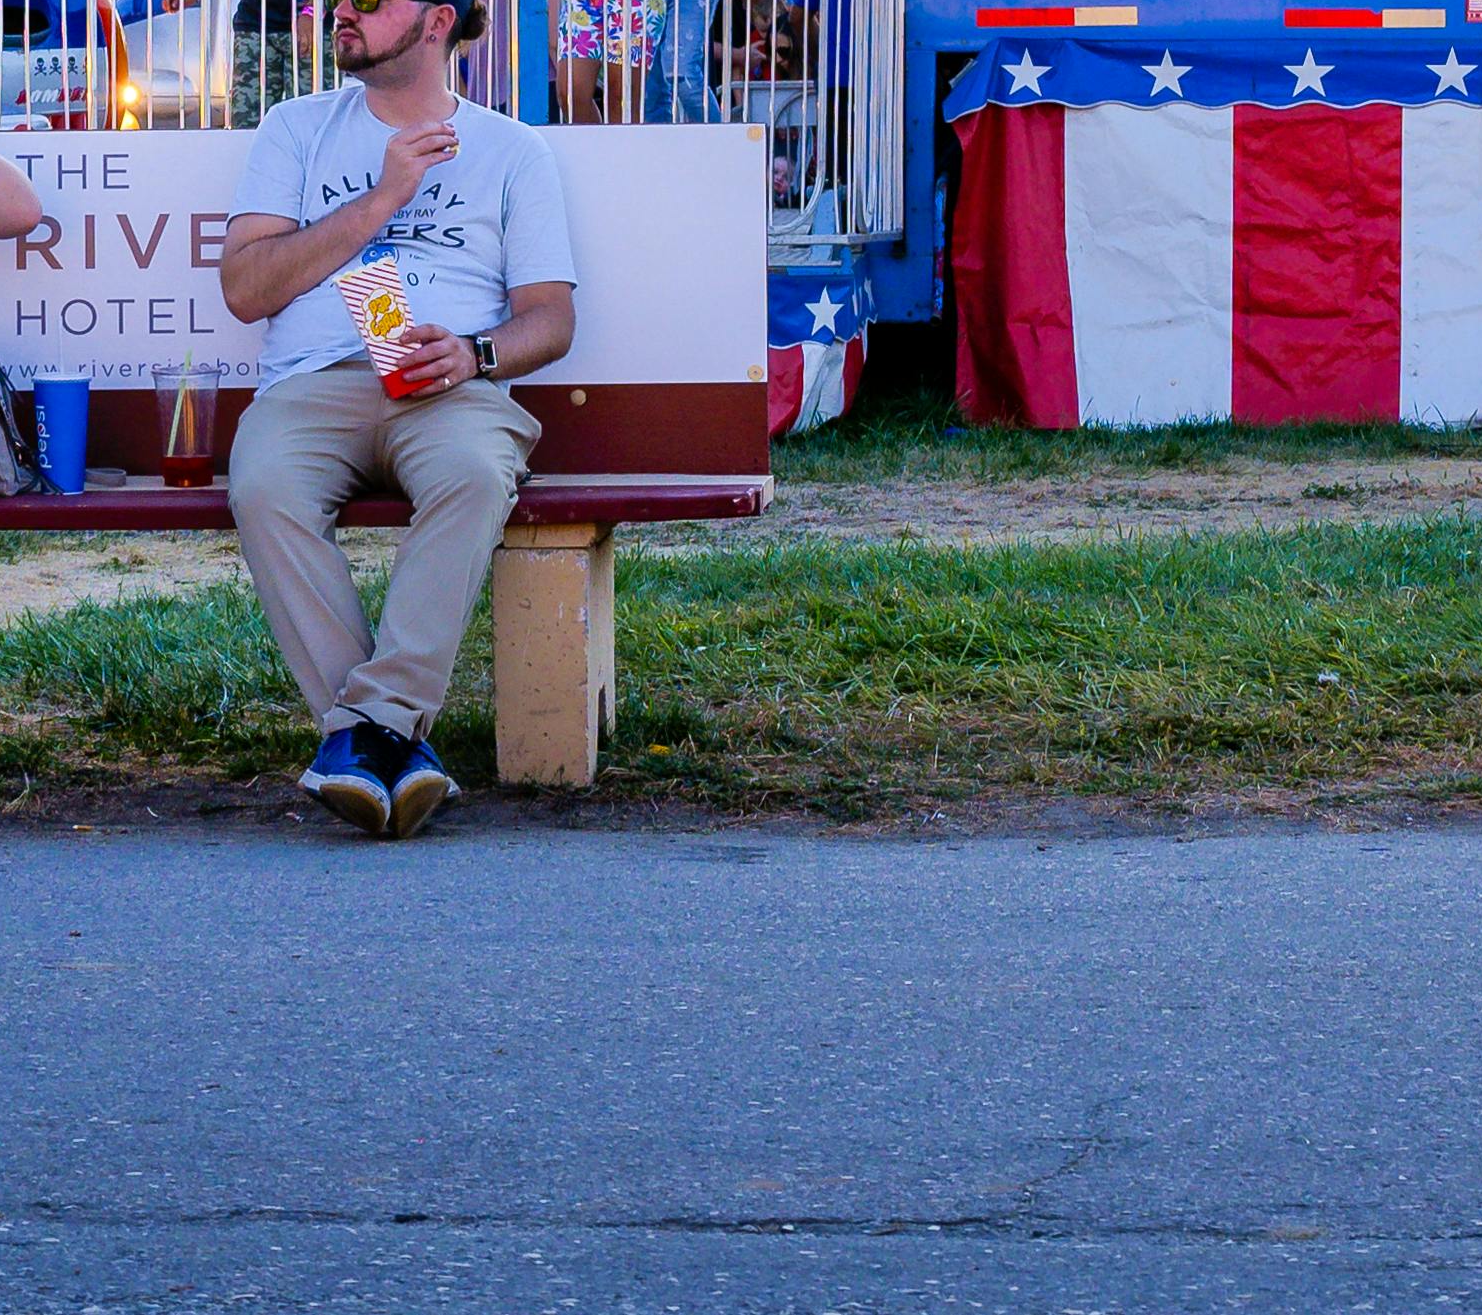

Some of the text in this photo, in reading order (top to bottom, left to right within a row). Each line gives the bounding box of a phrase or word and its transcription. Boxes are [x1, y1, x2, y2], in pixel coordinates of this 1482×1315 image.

[16, 152, 131, 191] THE
[413, 208, 437, 218] RAY
[422, 182, 466, 210] AY
[16, 213, 226, 272] RIVE
[15, 298, 216, 337] HOTEL
[37, 405, 53, 469] pepsi
